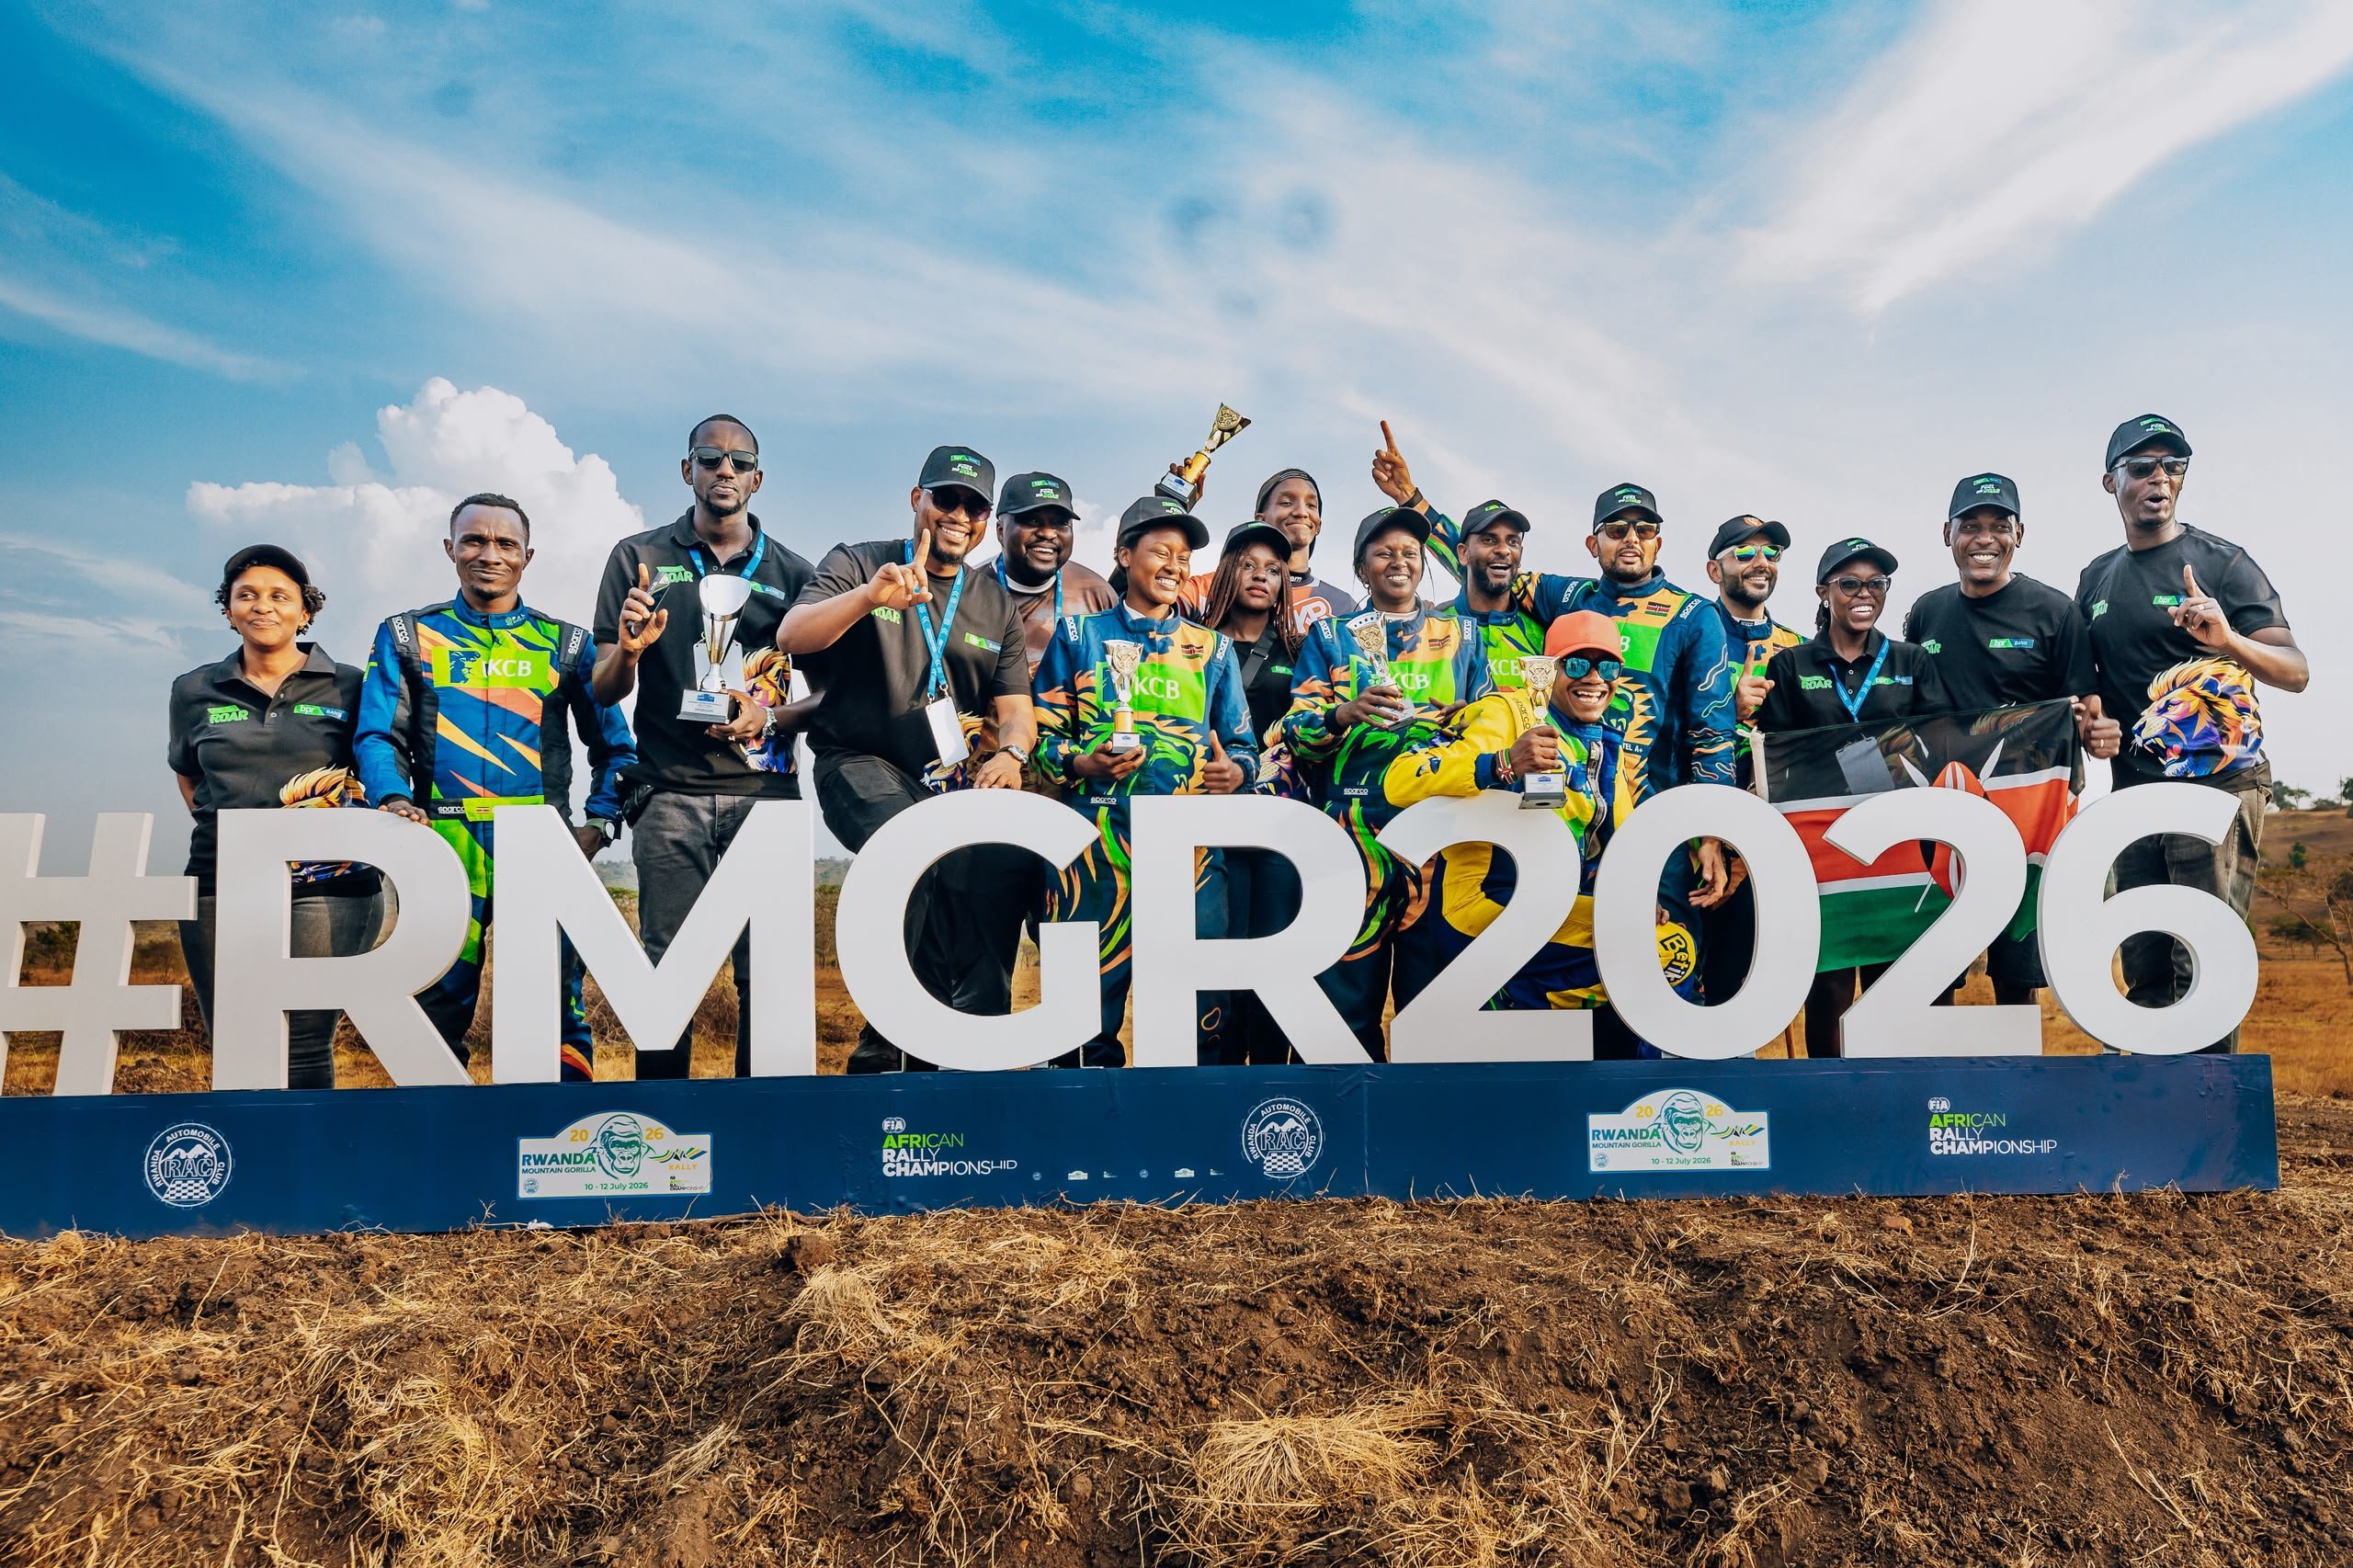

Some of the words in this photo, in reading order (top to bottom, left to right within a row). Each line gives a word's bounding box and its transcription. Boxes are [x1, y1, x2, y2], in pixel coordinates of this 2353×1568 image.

[667, 571, 693, 583] OAR
[1563, 581, 1579, 603] sparco
[1679, 598, 1702, 619] sparco
[392, 616, 410, 643] sparco
[1066, 616, 1079, 642] sparco
[484, 659, 532, 677] KCB
[1133, 676, 1180, 699] KCB
[1802, 678, 1833, 689] ROAR
[300, 705, 313, 714] bpr
[1513, 697, 1531, 730] sparco
[210, 710, 249, 724] ROAR
[1622, 742, 1632, 751] TEL
[1636, 1106, 1653, 1118] 20
[1706, 1105, 1723, 1117] 26
[1928, 1098, 1949, 1111] FIA
[882, 1119, 904, 1131] FIA
[1929, 1113, 2006, 1127] AFRICAN
[570, 1129, 589, 1142] 20
[645, 1128, 665, 1140] 26
[1247, 1123, 1260, 1159] RWANDA
[1261, 1104, 1312, 1124] AUTOMOBILE
[1305, 1135, 1316, 1158] CLUB
[1591, 1129, 1661, 1141] RWANDA
[1930, 1127, 1984, 1141] RALLY
[882, 1133, 963, 1148] AFRICAN
[1261, 1132, 1305, 1151] RAC
[1930, 1140, 2057, 1155] CHAMPIONSHIP
[151, 1150, 164, 1187] RWANDA
[165, 1129, 221, 1151] AUTOMOBILE
[211, 1162, 225, 1185] CLUB
[522, 1153, 596, 1165] RWANDA
[882, 1148, 940, 1163] RALLY
[1676, 1157, 1691, 1165] July
[165, 1158, 213, 1177] RAC
[611, 1182, 626, 1191] July
